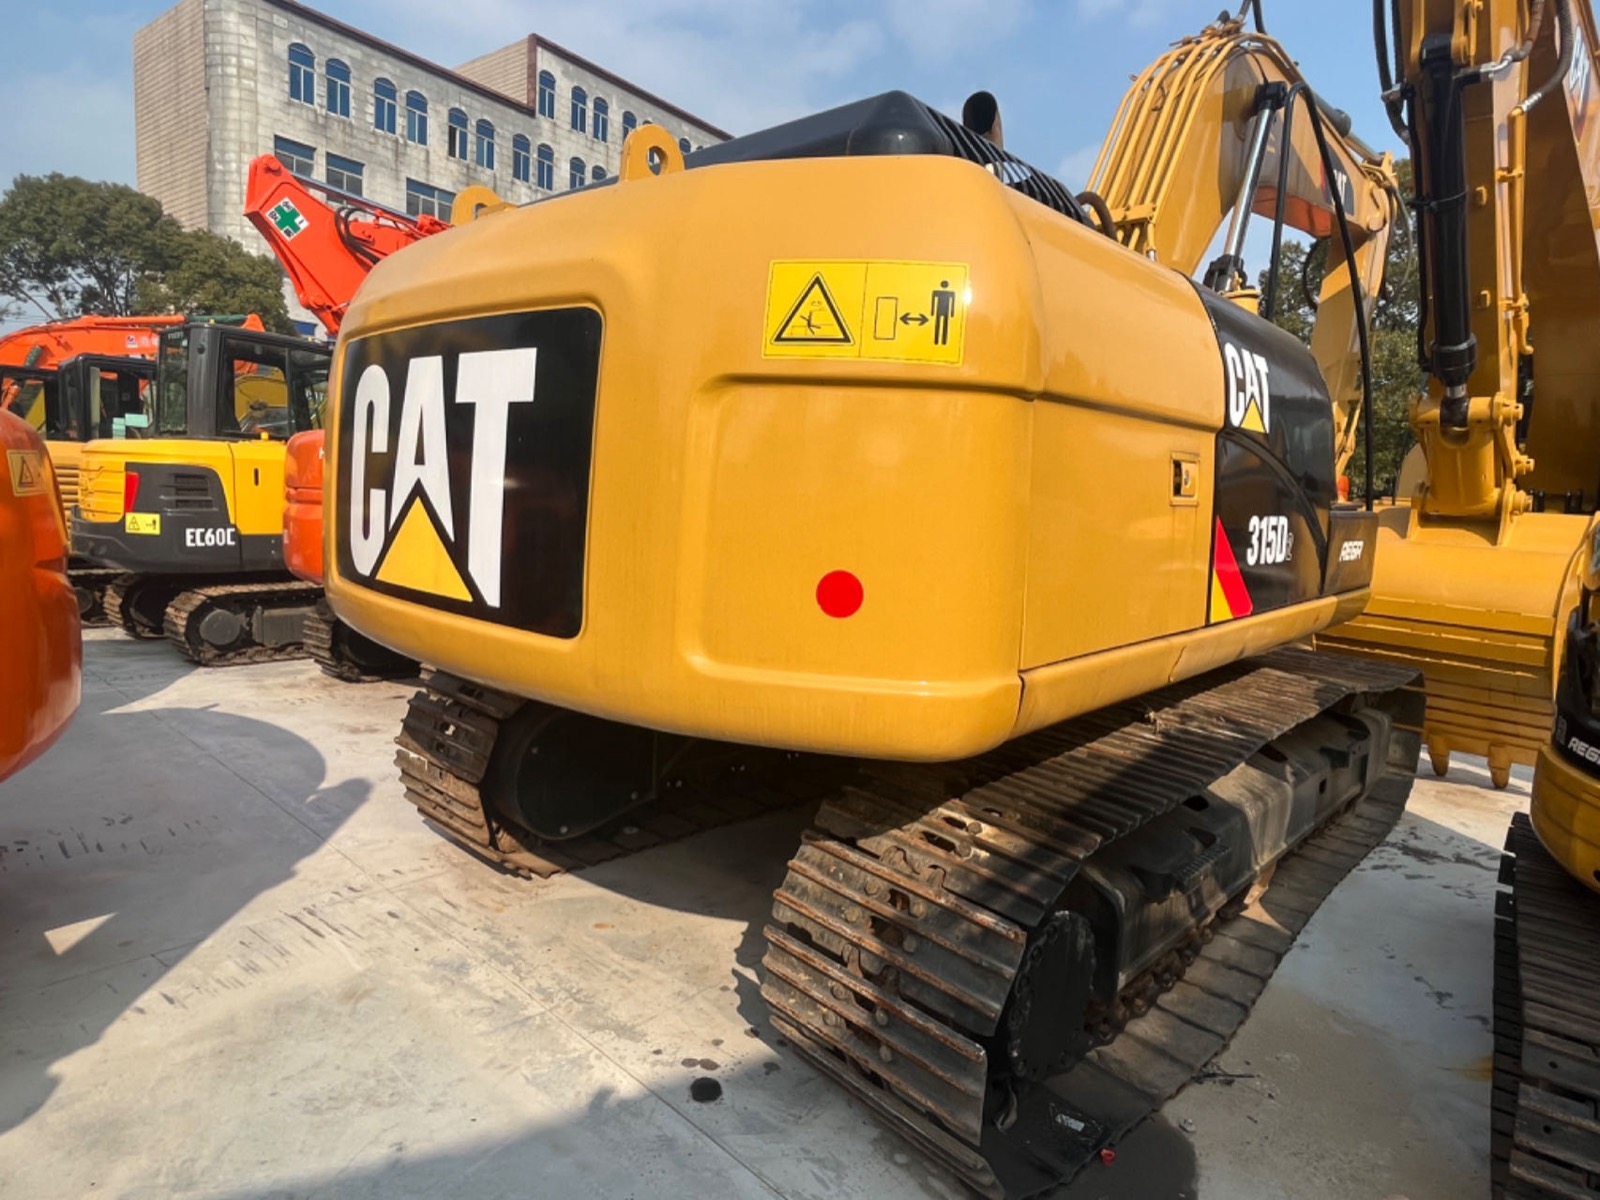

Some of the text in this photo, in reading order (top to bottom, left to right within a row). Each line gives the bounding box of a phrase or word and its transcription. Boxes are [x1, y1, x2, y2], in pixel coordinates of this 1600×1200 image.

[1224, 342, 1270, 434] CAT
[350, 347, 537, 608] CAT
[185, 527, 236, 547] EC60C
